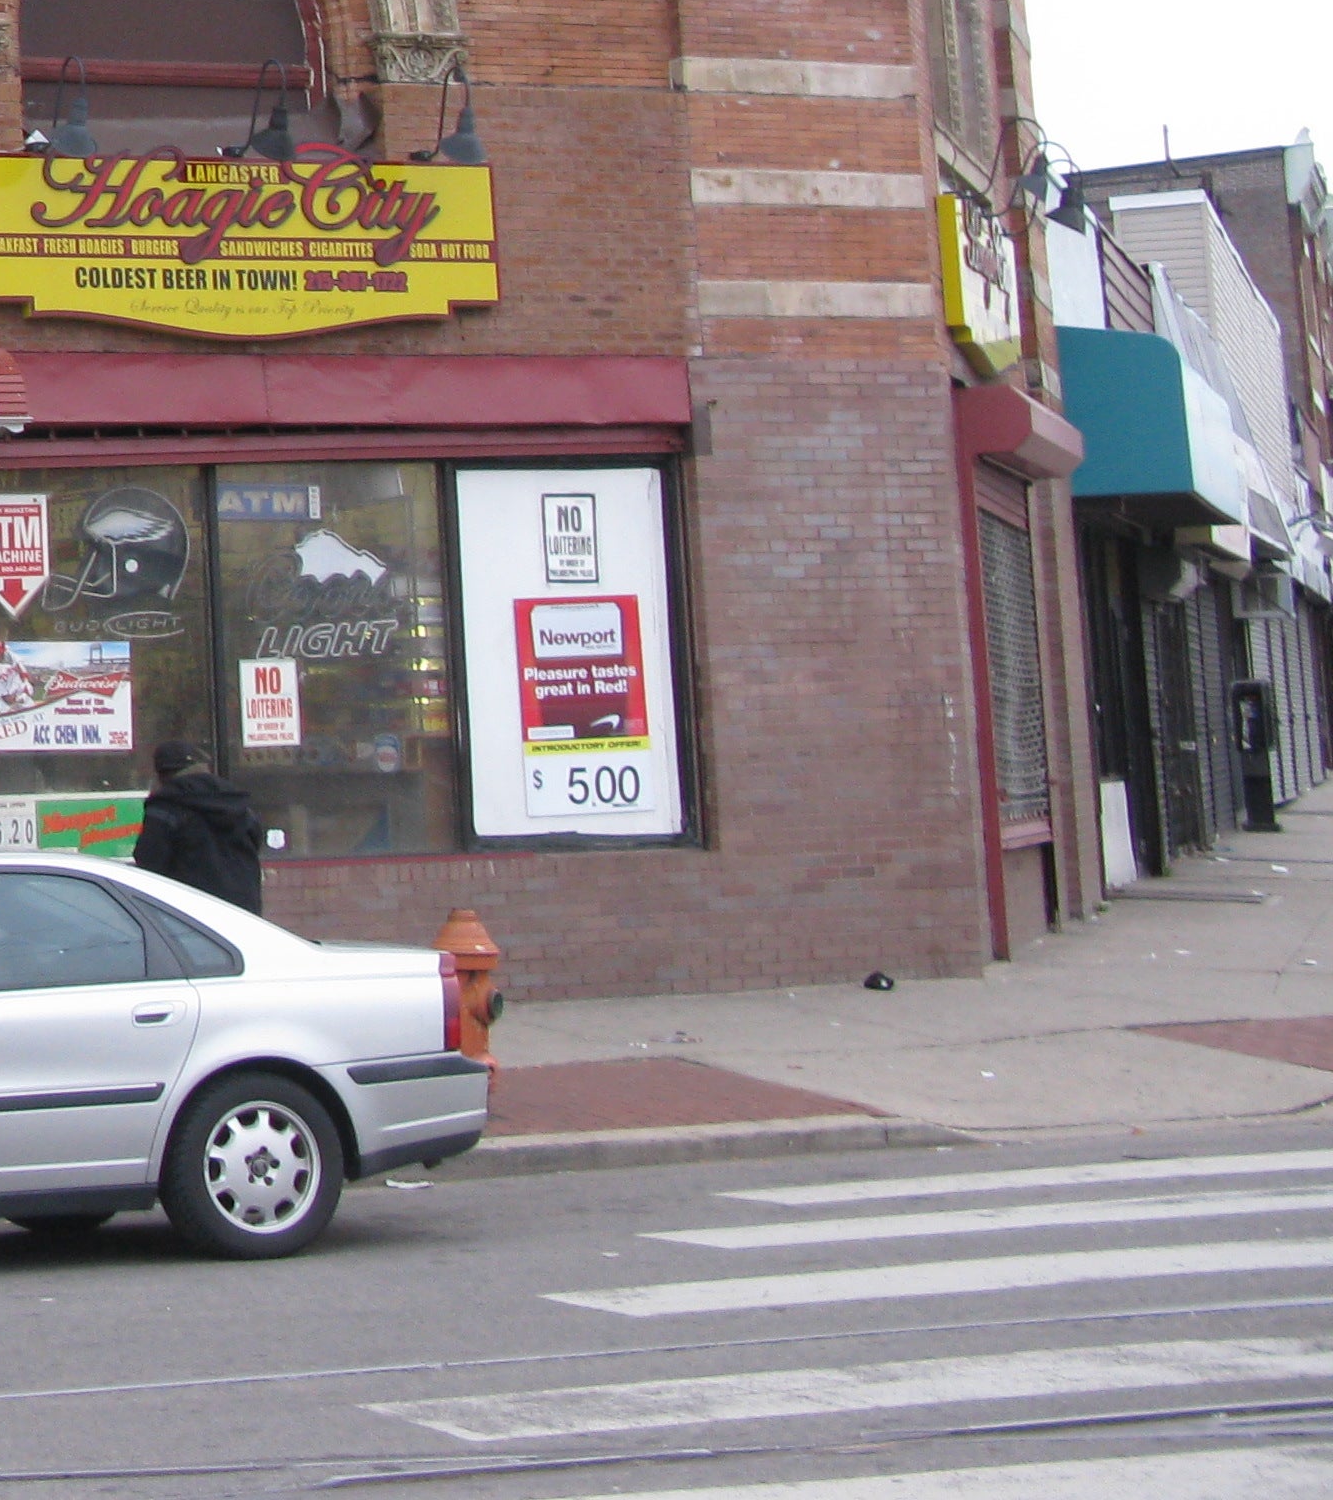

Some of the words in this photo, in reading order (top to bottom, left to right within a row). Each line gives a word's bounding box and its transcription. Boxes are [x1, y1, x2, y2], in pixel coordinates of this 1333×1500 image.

[186, 163, 280, 184] LANCASTER
[30, 146, 295, 265] Hoagie
[284, 141, 441, 268] City
[44, 238, 76, 255] FRESH
[78, 239, 125, 256] HOAGIES
[131, 239, 180, 256] BURGERS
[219, 240, 305, 258] SANDWICHES
[309, 241, 374, 259] CIGARETTES
[409, 242, 437, 259] SODA
[441, 243, 462, 260] HOT
[463, 243, 490, 260] FOOD
[75, 266, 157, 290] COLDEST
[162, 268, 207, 290] BEER
[212, 269, 231, 291] IN
[236, 269, 298, 292] TOWN!
[218, 490, 306, 513] ATM
[556, 504, 583, 533] NO
[548, 535, 593, 556] LOITERING
[116, 616, 182, 631] LIGHT
[256, 619, 399, 660] LIGHT
[538, 628, 616, 648] Newport
[254, 666, 283, 695] NO
[523, 667, 588, 681] Pleasure
[590, 664, 638, 678] tastes
[535, 681, 574, 699] great
[577, 680, 591, 695] in
[594, 679, 629, 694] Red!
[246, 698, 294, 719] LOITERING
[531, 741, 605, 752] INTRODUCTORY
[607, 740, 641, 749] OFFER!
[532, 769, 543, 791] $
